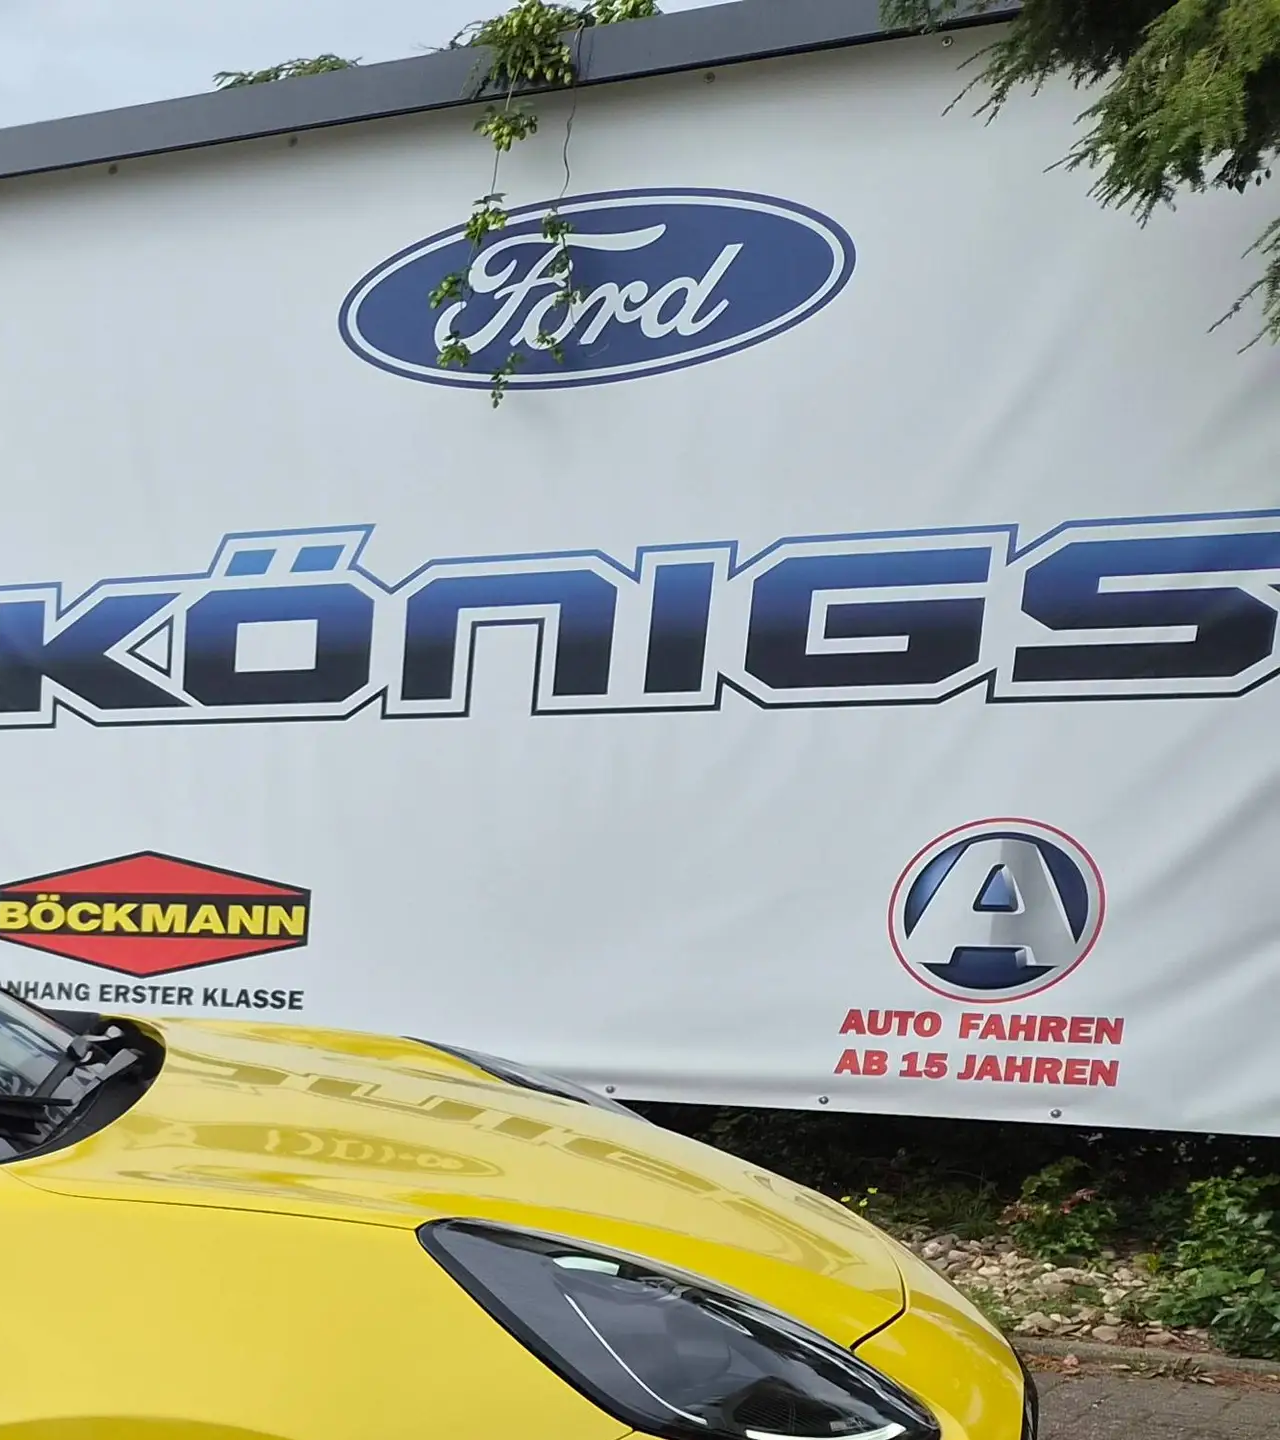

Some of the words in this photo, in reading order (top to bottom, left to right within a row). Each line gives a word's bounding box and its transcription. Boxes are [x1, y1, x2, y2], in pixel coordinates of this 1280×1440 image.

[434, 224, 743, 354] Ford
[98, 984, 195, 1007] ERSTER
[202, 987, 305, 1011] KLASSE
[838, 1008, 942, 1038] AUTO
[958, 1012, 1125, 1045] FAHREN
[833, 1048, 889, 1076] AB
[898, 1051, 949, 1080] 15
[956, 1054, 1120, 1087] JAHREN
